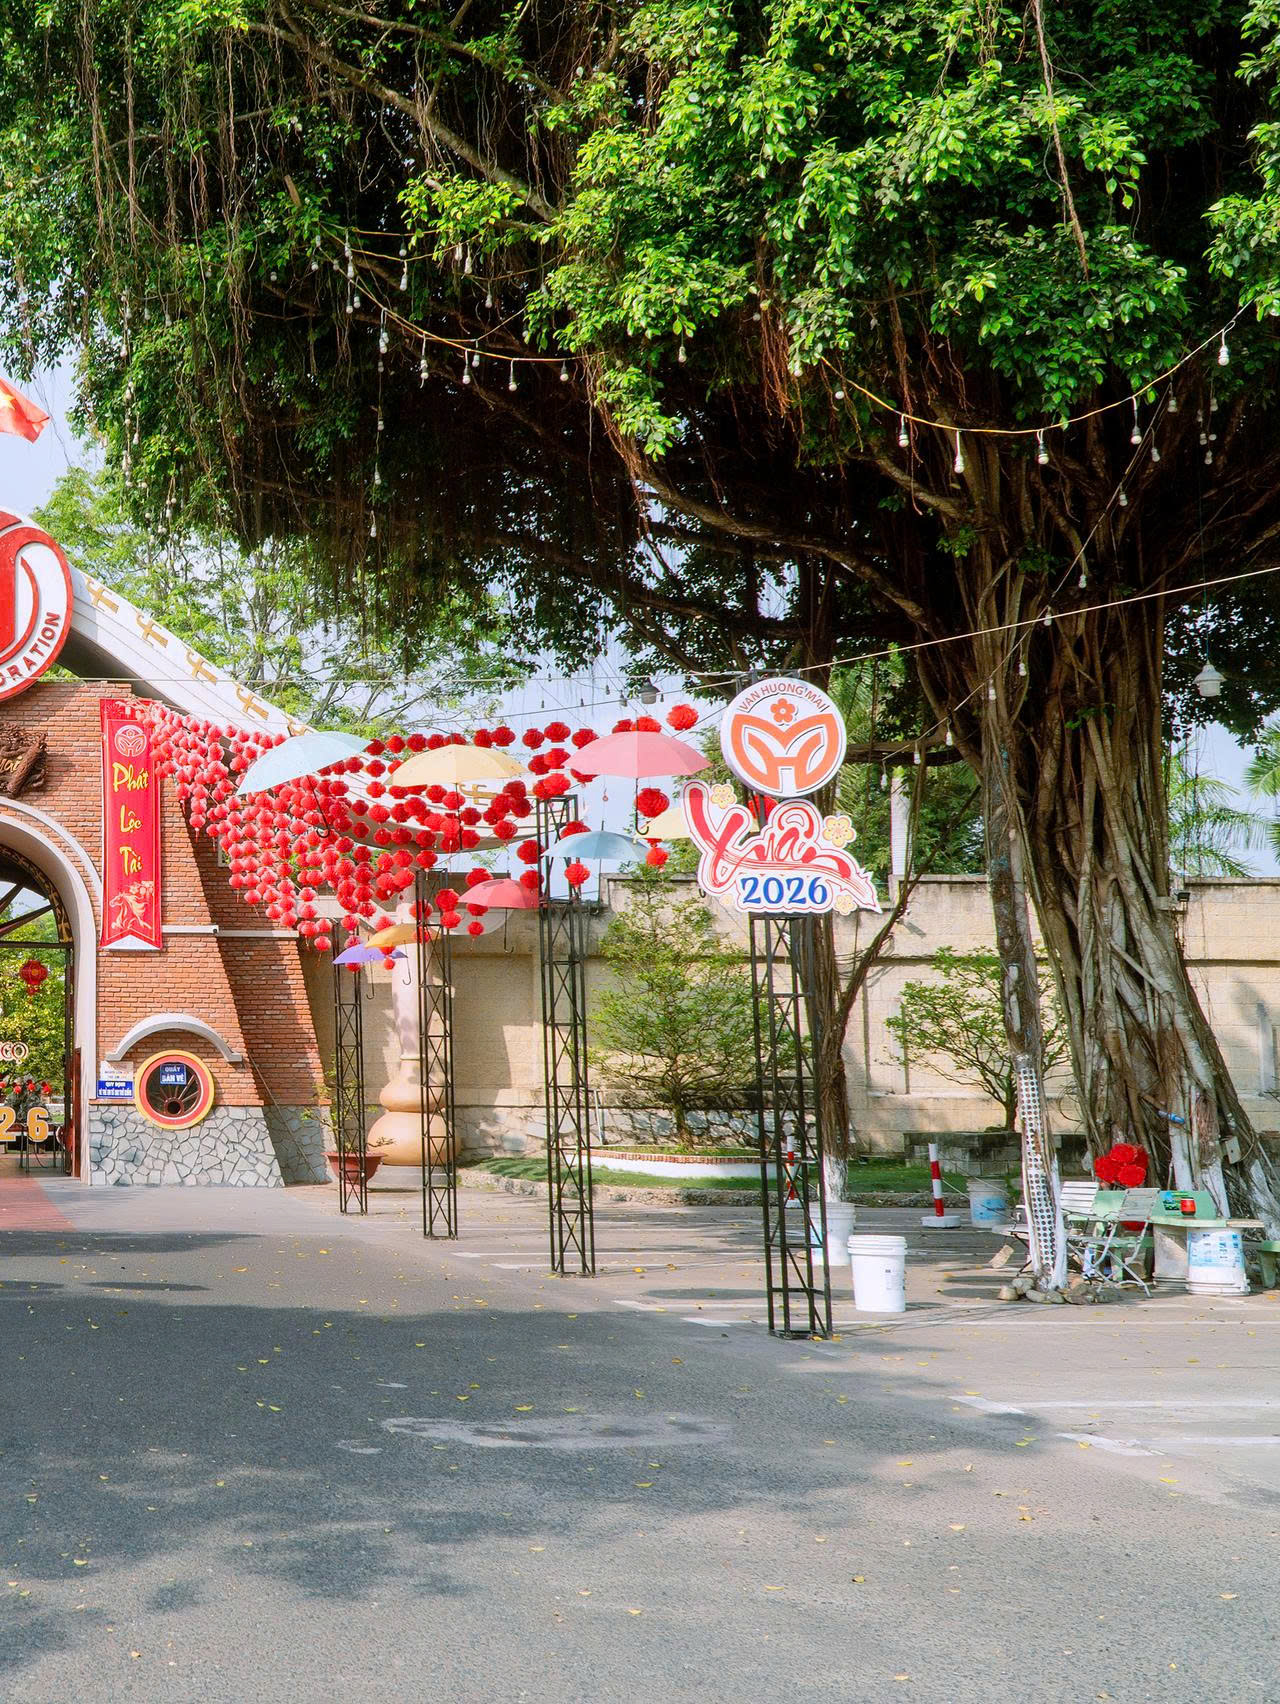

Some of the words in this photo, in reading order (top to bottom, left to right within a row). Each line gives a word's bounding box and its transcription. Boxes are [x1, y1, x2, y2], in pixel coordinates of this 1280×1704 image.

[739, 690, 761, 711] VAN
[112, 761, 149, 793] Phát
[119, 804, 142, 833] Lộc
[119, 846, 142, 876] Tài
[740, 876, 828, 905] 2026
